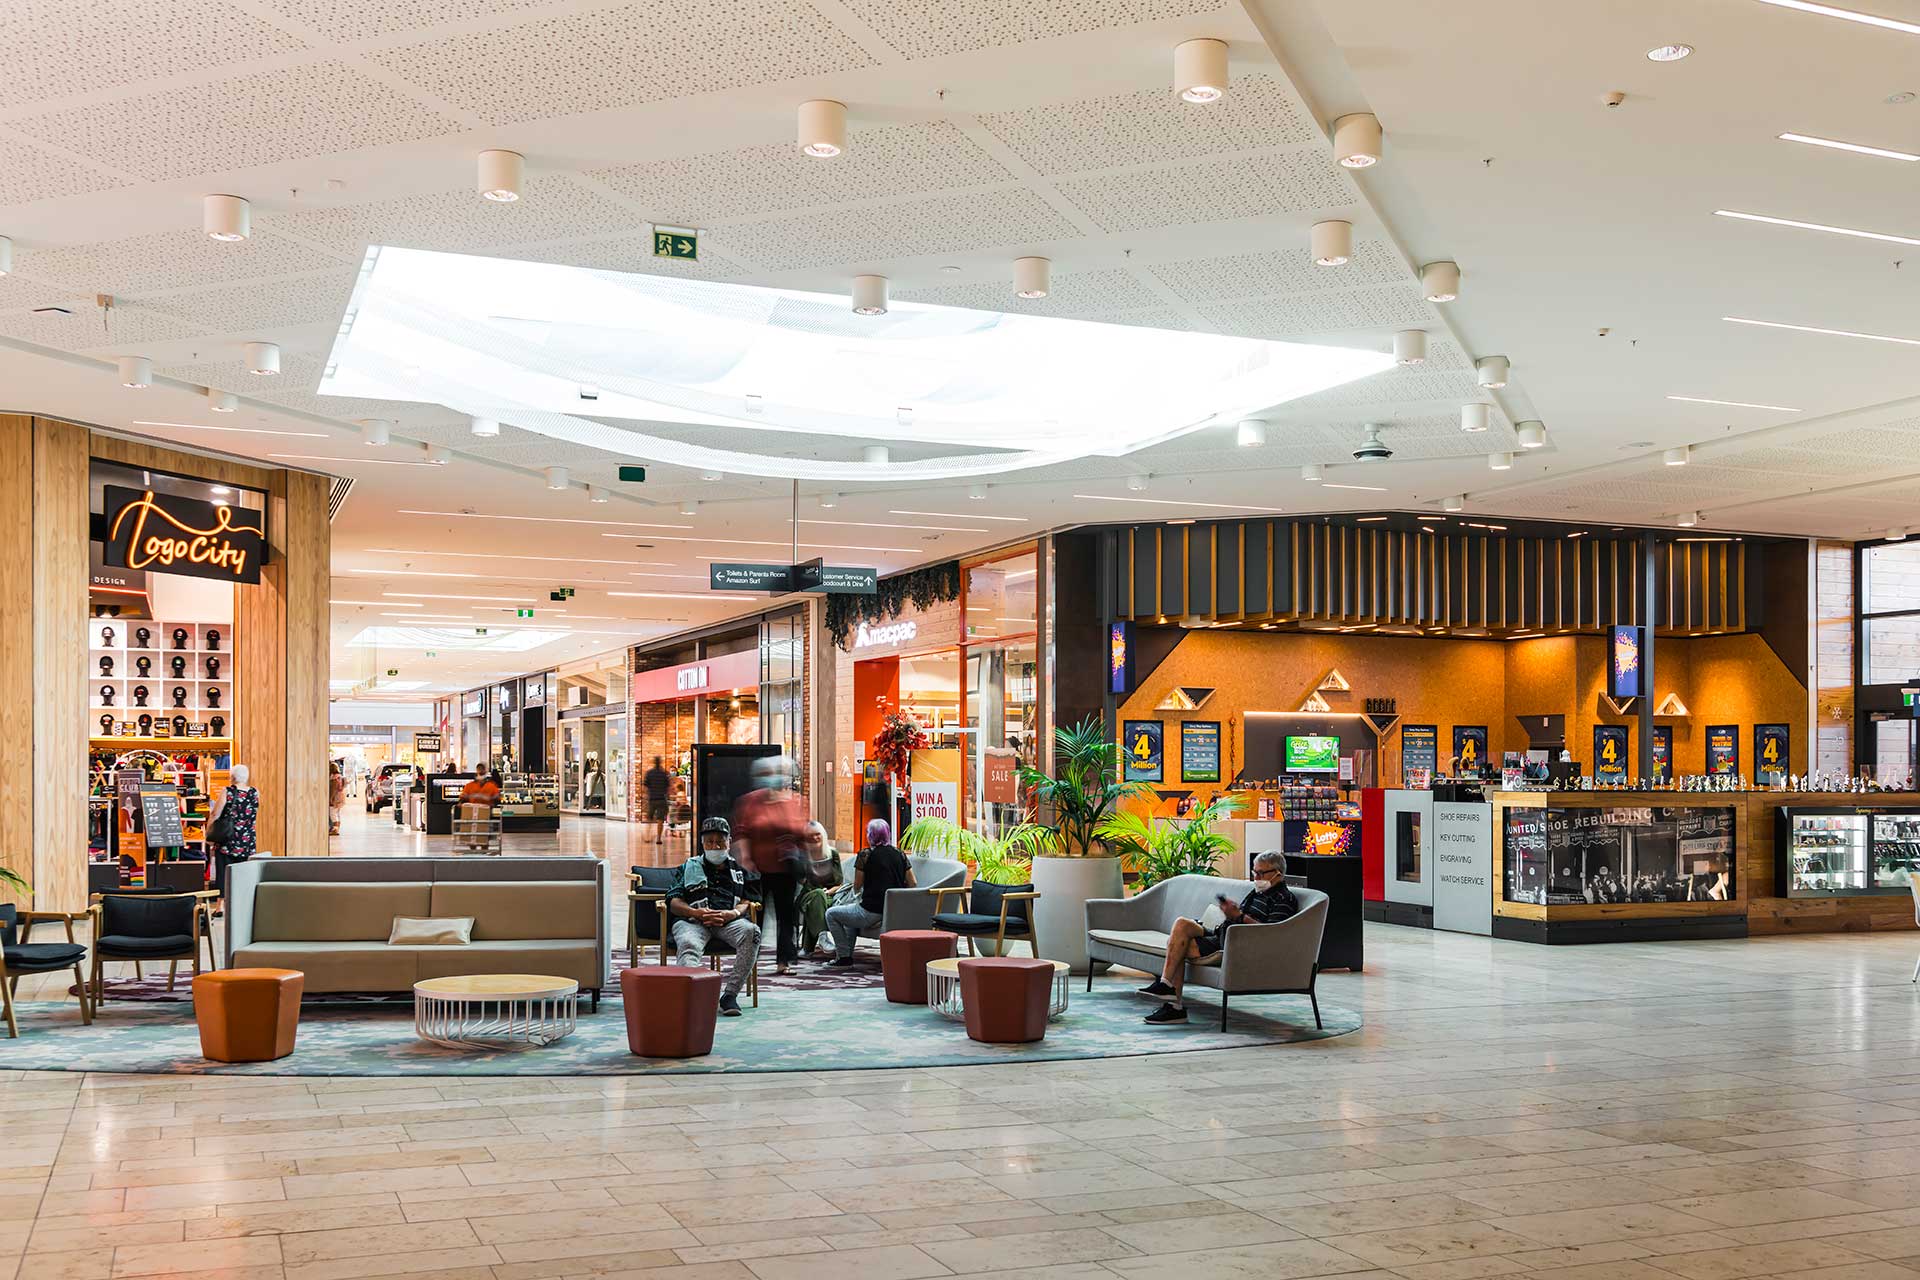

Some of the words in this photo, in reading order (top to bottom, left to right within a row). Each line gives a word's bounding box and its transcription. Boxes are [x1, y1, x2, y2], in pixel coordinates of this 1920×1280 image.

[94, 576, 126, 585] DESIGN
[869, 621, 917, 646] macpac
[1131, 761, 1157, 769] Million
[1600, 764, 1623, 773] Million
[1761, 764, 1785, 773] Million
[991, 770, 1009, 782] SALE
[916, 792, 935, 805] WIN
[936, 792, 944, 805] A
[916, 806, 948, 819] $1000
[1440, 813, 1456, 821] SHOE
[1456, 813, 1480, 822] REPAIRS
[1508, 823, 1536, 835] UNITED
[1315, 831, 1338, 843] Lotto
[1440, 833, 1451, 842] KEY
[1451, 834, 1476, 843] CUTTING
[1440, 854, 1472, 864] ENGRAVING
[1440, 875, 1461, 884] WATCH
[1461, 876, 1485, 886] SERVICE
